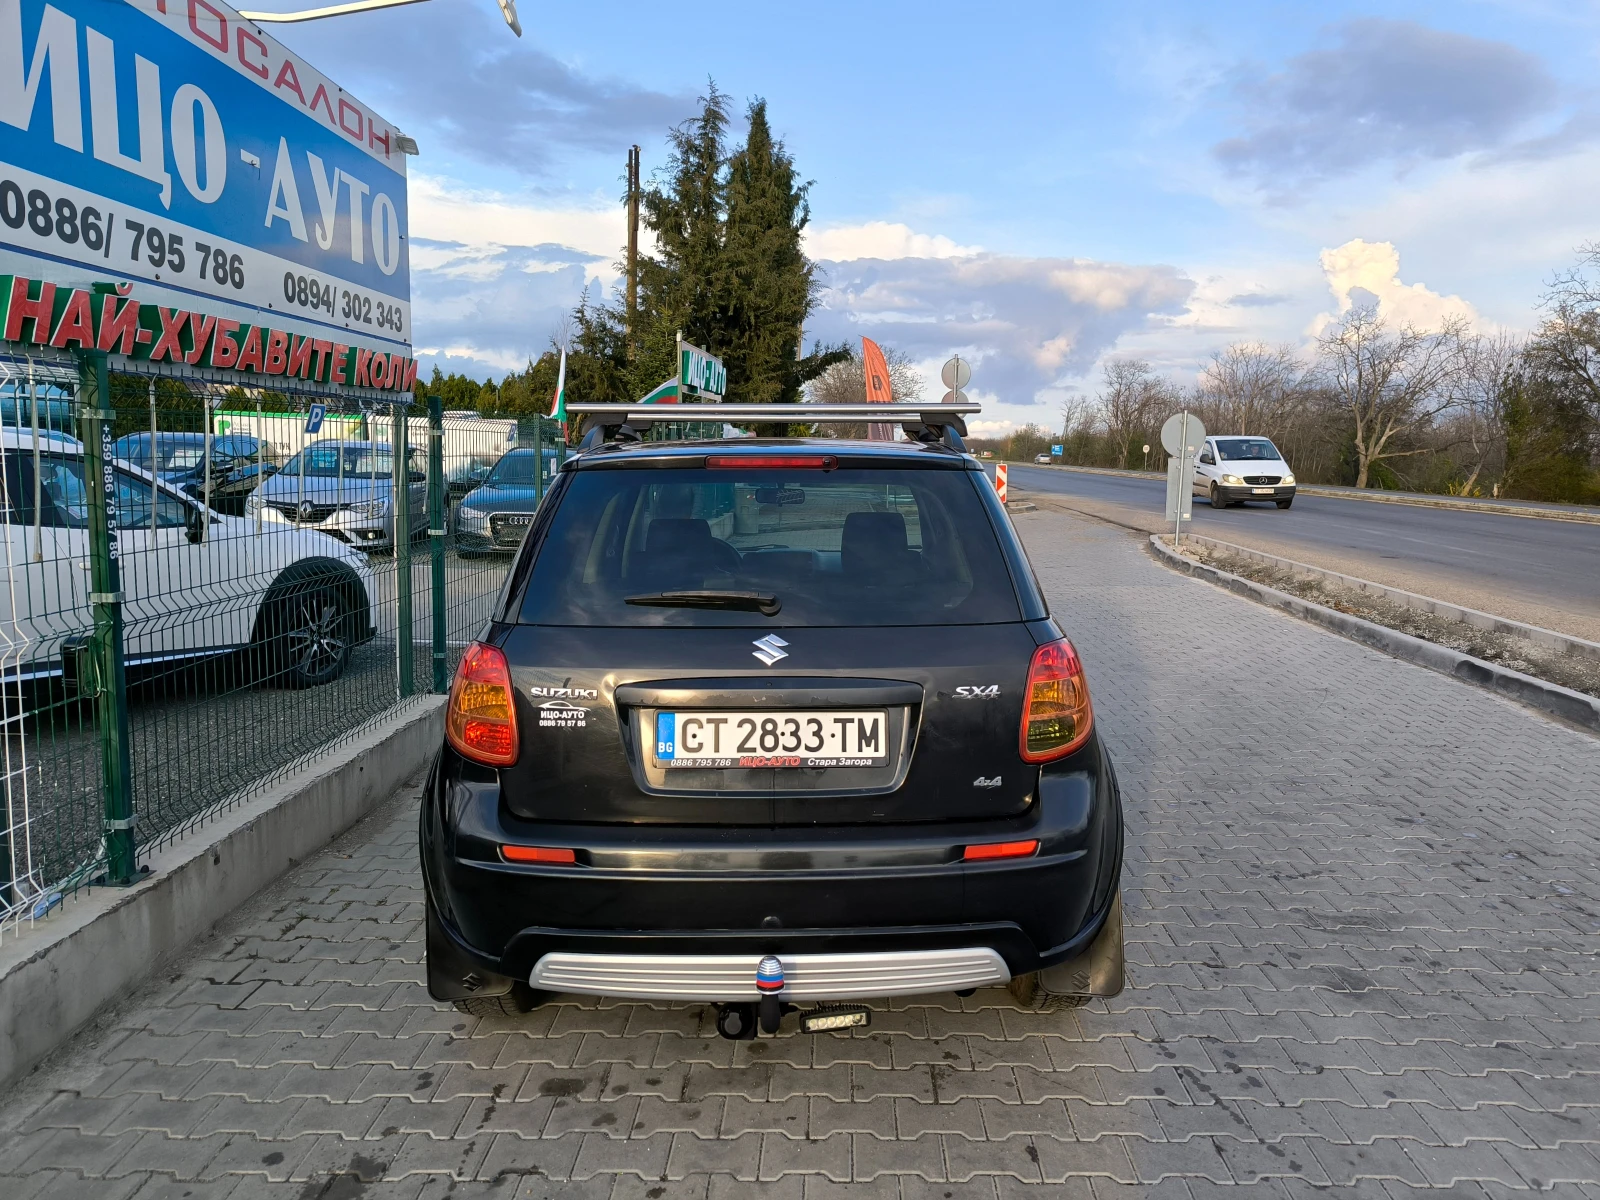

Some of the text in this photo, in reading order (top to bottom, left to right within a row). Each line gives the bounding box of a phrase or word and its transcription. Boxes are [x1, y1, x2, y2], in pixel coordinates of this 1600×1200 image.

[0, 180, 245, 289] 0886/ 795 786
[283, 271, 403, 333] 0894/ 302 343
[3, 275, 418, 392] НАЙ-ХУБАВИТЕ КОЛИ
[308, 407, 322, 430] P
[102, 424, 119, 559] +359 886 79 57 86
[530, 687, 598, 700] SUZUKI
[955, 684, 1001, 697] SX4
[539, 719, 556, 727] 0886
[540, 710, 585, 720] ИЦО-АУТО
[681, 717, 879, 753] CT 2833 TM
[657, 741, 674, 753] BG
[670, 755, 872, 768] 0886 795 786 ИЦО-АУТО Стара Загора
